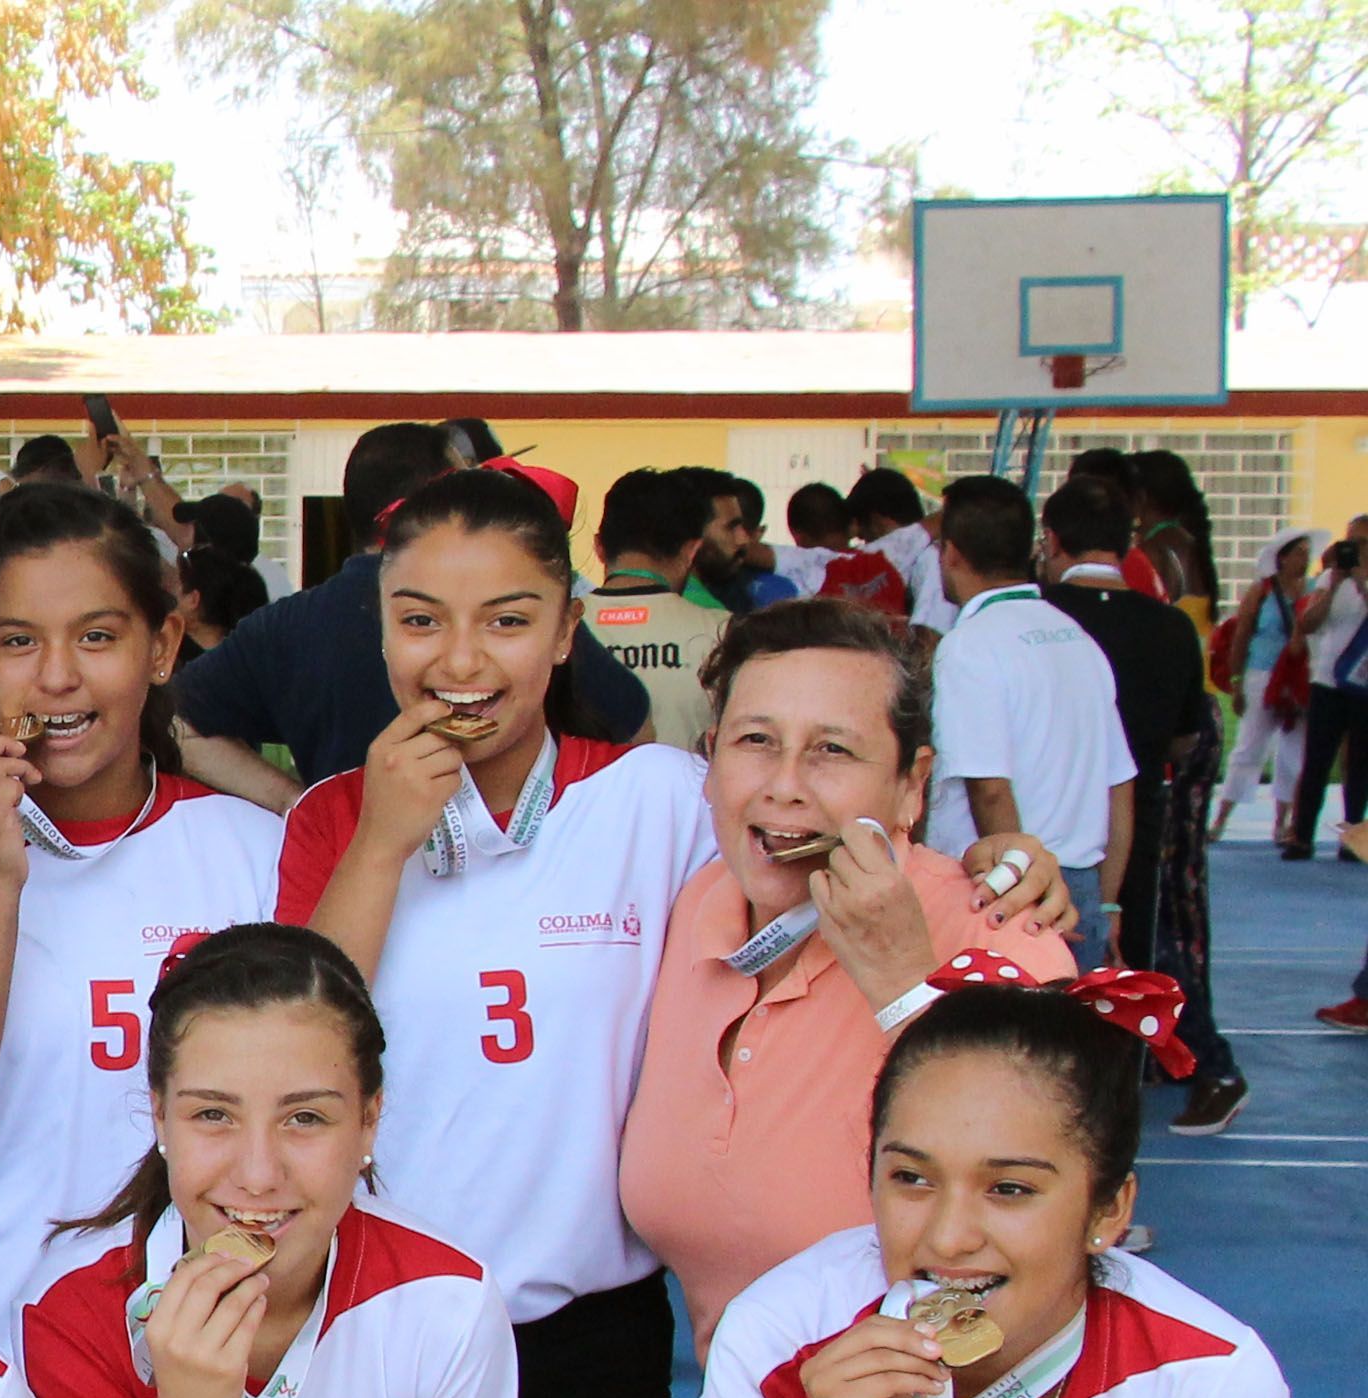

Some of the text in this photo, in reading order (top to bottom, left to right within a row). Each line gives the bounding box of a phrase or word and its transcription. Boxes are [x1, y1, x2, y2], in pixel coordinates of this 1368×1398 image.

[599, 610, 645, 622] CHARLY
[538, 912, 613, 930] COLIMA
[90, 979, 141, 1071] 5
[479, 969, 534, 1064] 3
